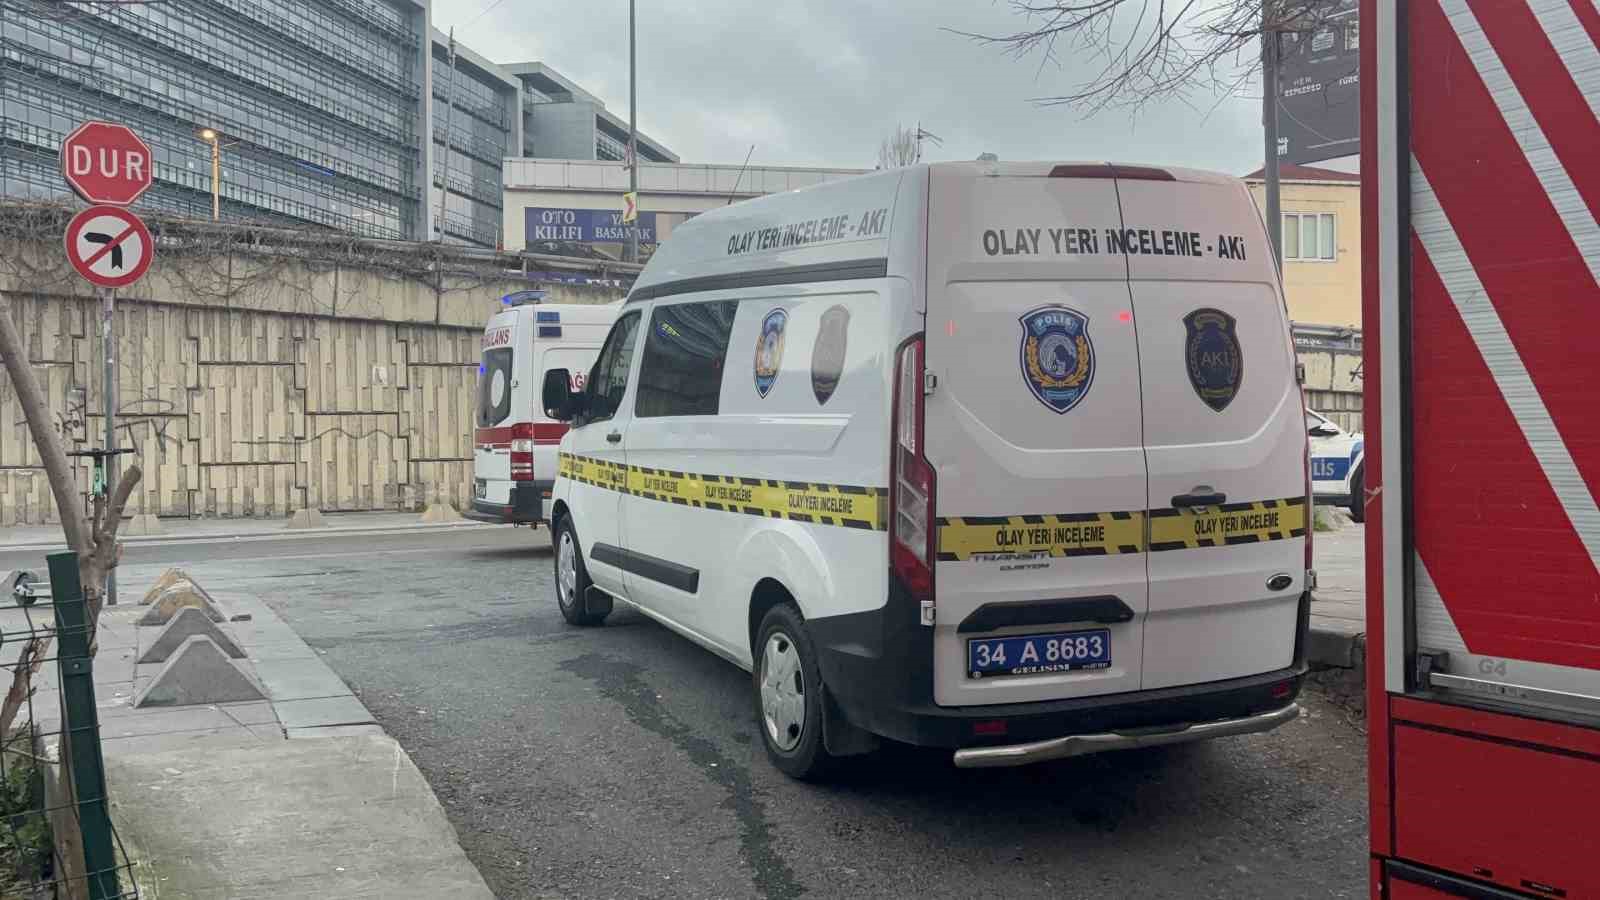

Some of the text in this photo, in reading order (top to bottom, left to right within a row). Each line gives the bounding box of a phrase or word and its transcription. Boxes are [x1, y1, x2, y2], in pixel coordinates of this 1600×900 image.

[73, 145, 144, 181] DUR
[541, 210, 576, 225] OTO
[728, 231, 756, 255] OLAY
[983, 228, 1042, 256] OLAY
[1313, 458, 1335, 476] LİS
[788, 493, 804, 508] OLAY
[1194, 518, 1217, 535] OLAY
[996, 529, 1024, 546] OLAY
[976, 635, 1103, 667] 34 A 8683
[1478, 658, 1507, 677] G4
